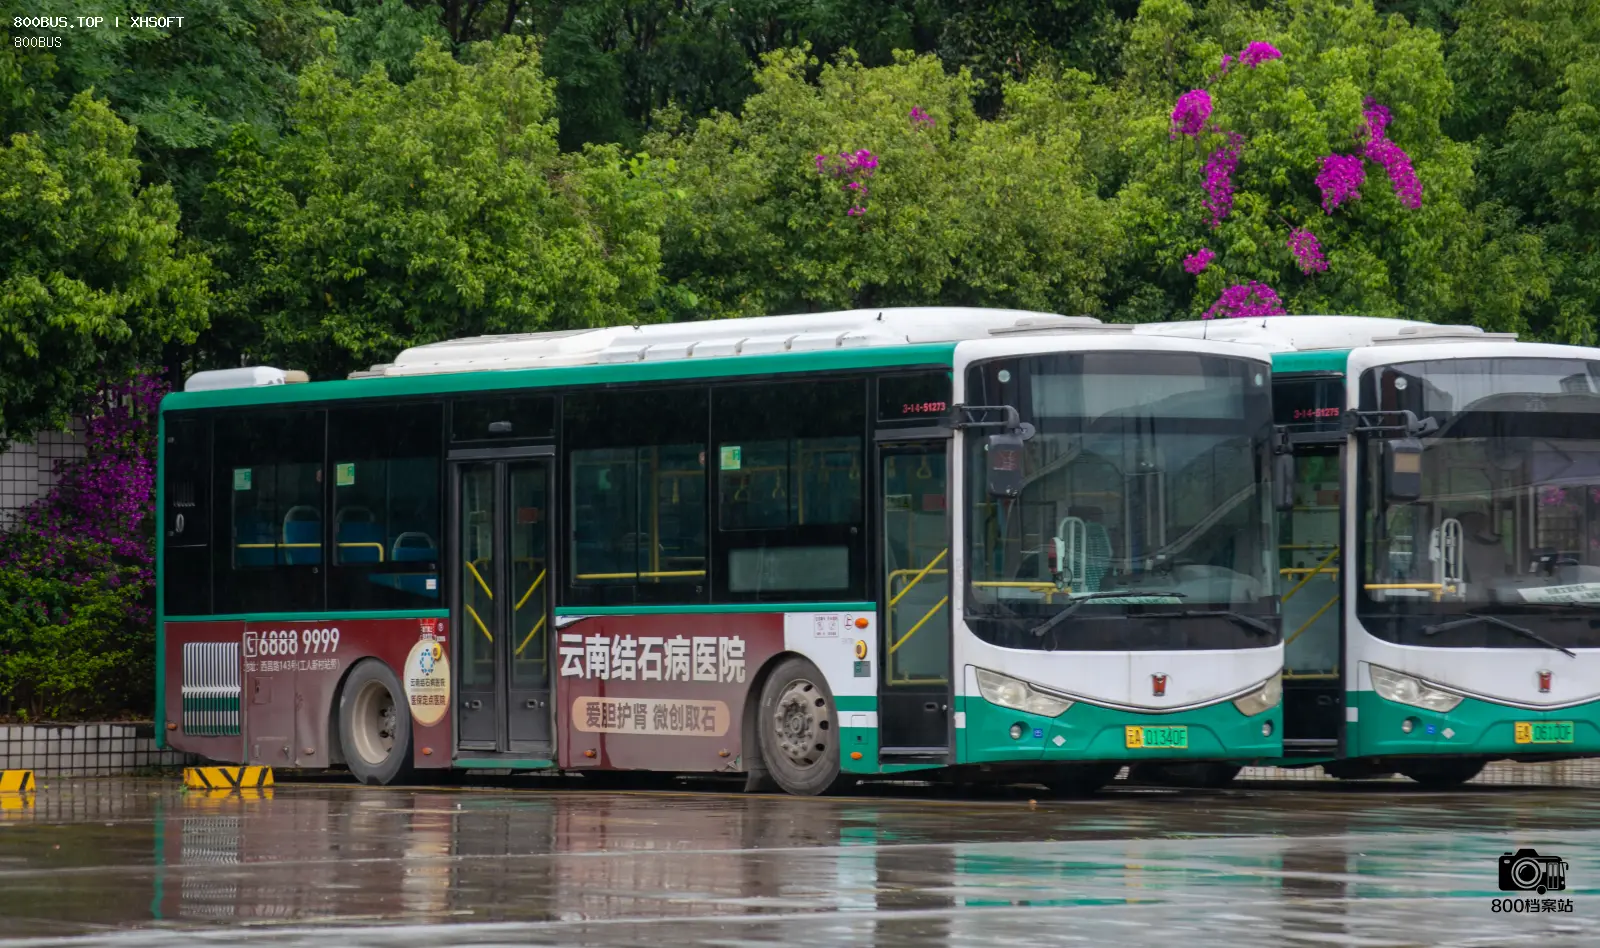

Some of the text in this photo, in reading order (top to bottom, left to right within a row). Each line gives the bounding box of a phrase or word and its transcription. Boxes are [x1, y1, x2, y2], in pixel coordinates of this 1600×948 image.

[259, 627, 340, 656] 6888 9999
[559, 633, 746, 683] 云南结石病医院
[411, 694, 446, 706] 医保定点医院
[585, 701, 717, 733] 爱胆护肾 微创取石
